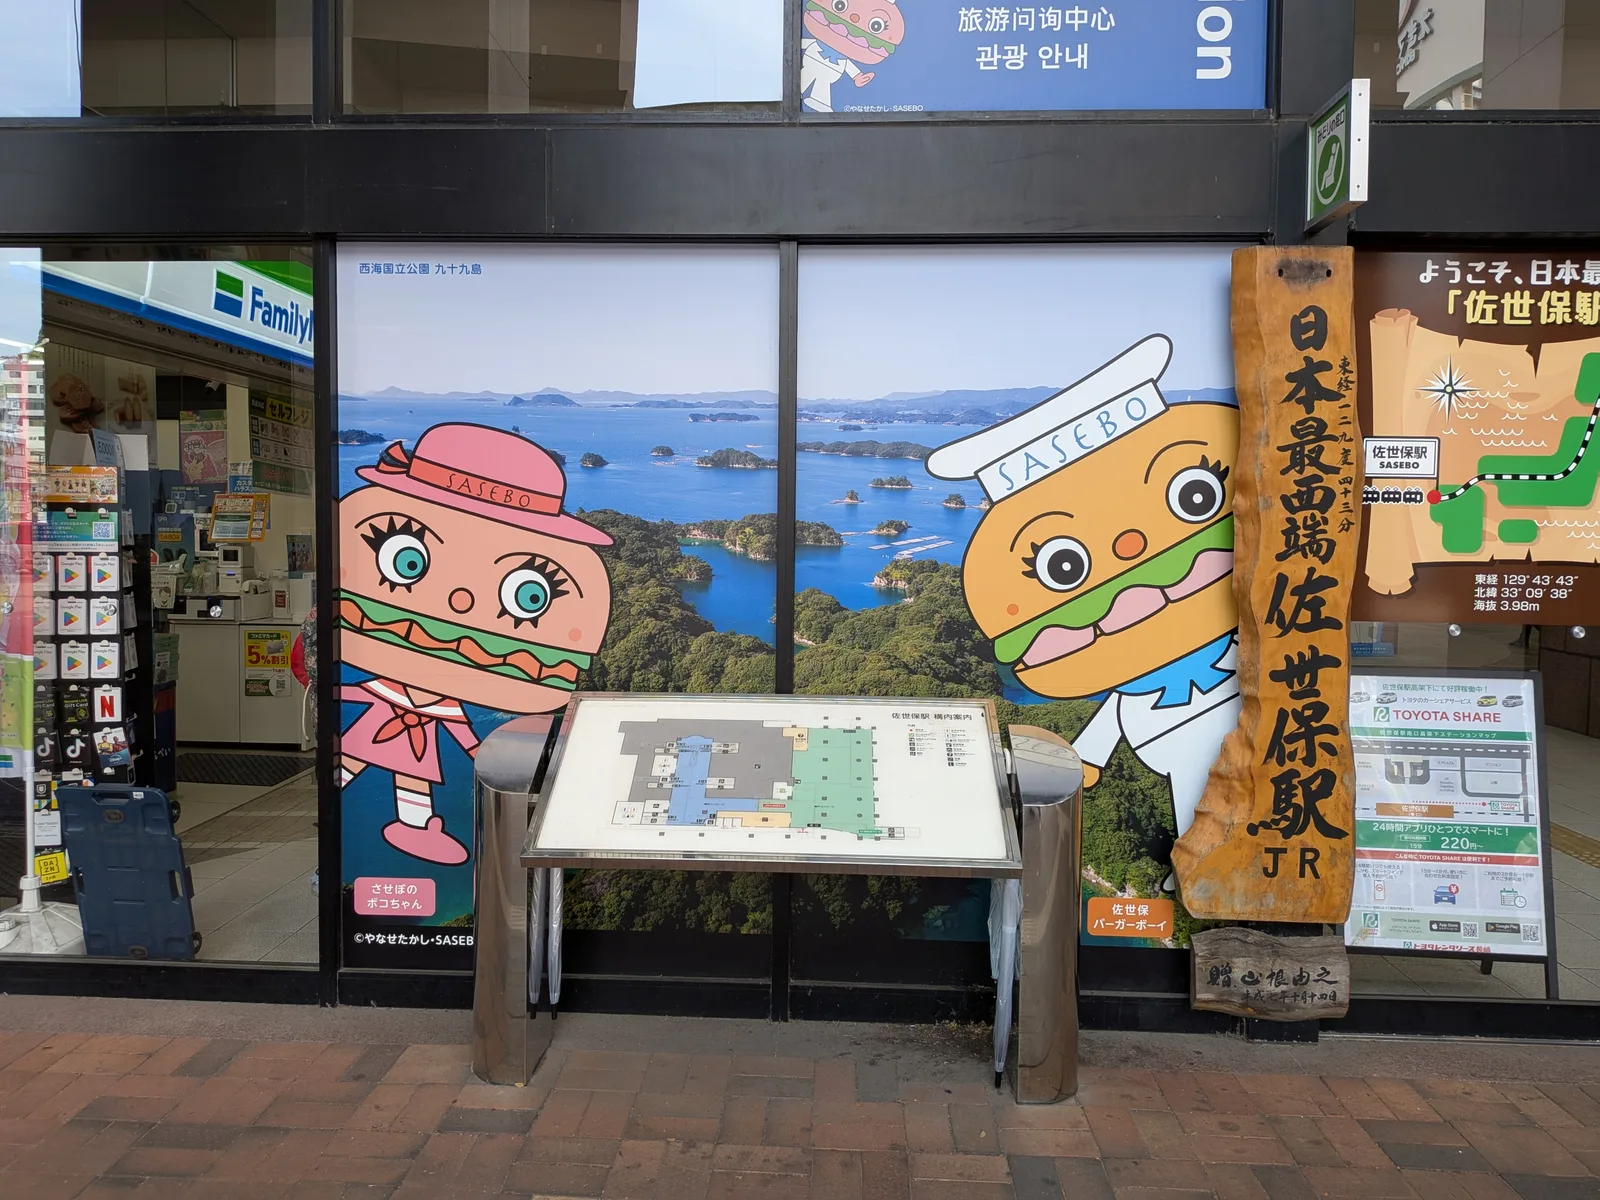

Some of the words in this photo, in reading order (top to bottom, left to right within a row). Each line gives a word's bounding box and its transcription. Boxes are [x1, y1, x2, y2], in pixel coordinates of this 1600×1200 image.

[957, 6, 1116, 32] 旅游问询中心
[1196, 0, 1233, 80] on
[975, 43, 1028, 71] 관광
[1039, 43, 1090, 71] 안내
[1317, 109, 1345, 143] みどりの窓口
[359, 263, 430, 276] 西海国立公園
[435, 263, 482, 276] 九十九島
[1419, 259, 1600, 286] ようこそ、日本最
[1448, 289, 1600, 326] 「佐世保駅
[999, 396, 1147, 491] SASEBO
[1336, 355, 1356, 534] 東経一二九度四十三分
[1372, 445, 1428, 460] 佐世保駅
[1379, 461, 1420, 470] SASEBO
[446, 473, 531, 508] SASEBO
[1247, 304, 1349, 839] 日本最西端佐世保駅
[1474, 574, 1499, 585] 東経
[1503, 574, 1530, 585] 129°
[1474, 587, 1498, 598] 北緯
[1501, 587, 1522, 598] 33°
[1473, 600, 1497, 611] 海抜
[1500, 600, 1540, 611] 3.98m
[101, 695, 115, 717] N
[891, 712, 930, 720] 佐世保駅
[1393, 709, 1450, 722] TOYOTA
[1453, 711, 1501, 723] SHARE
[1373, 823, 1510, 836] 24時間アプリひとつでスマートに！
[1263, 847, 1321, 879] JR
[372, 884, 417, 895] させぼの
[367, 898, 422, 909] ボコちゃん
[1112, 903, 1149, 916] 佐世保
[1094, 918, 1167, 931] バーガーボーイ
